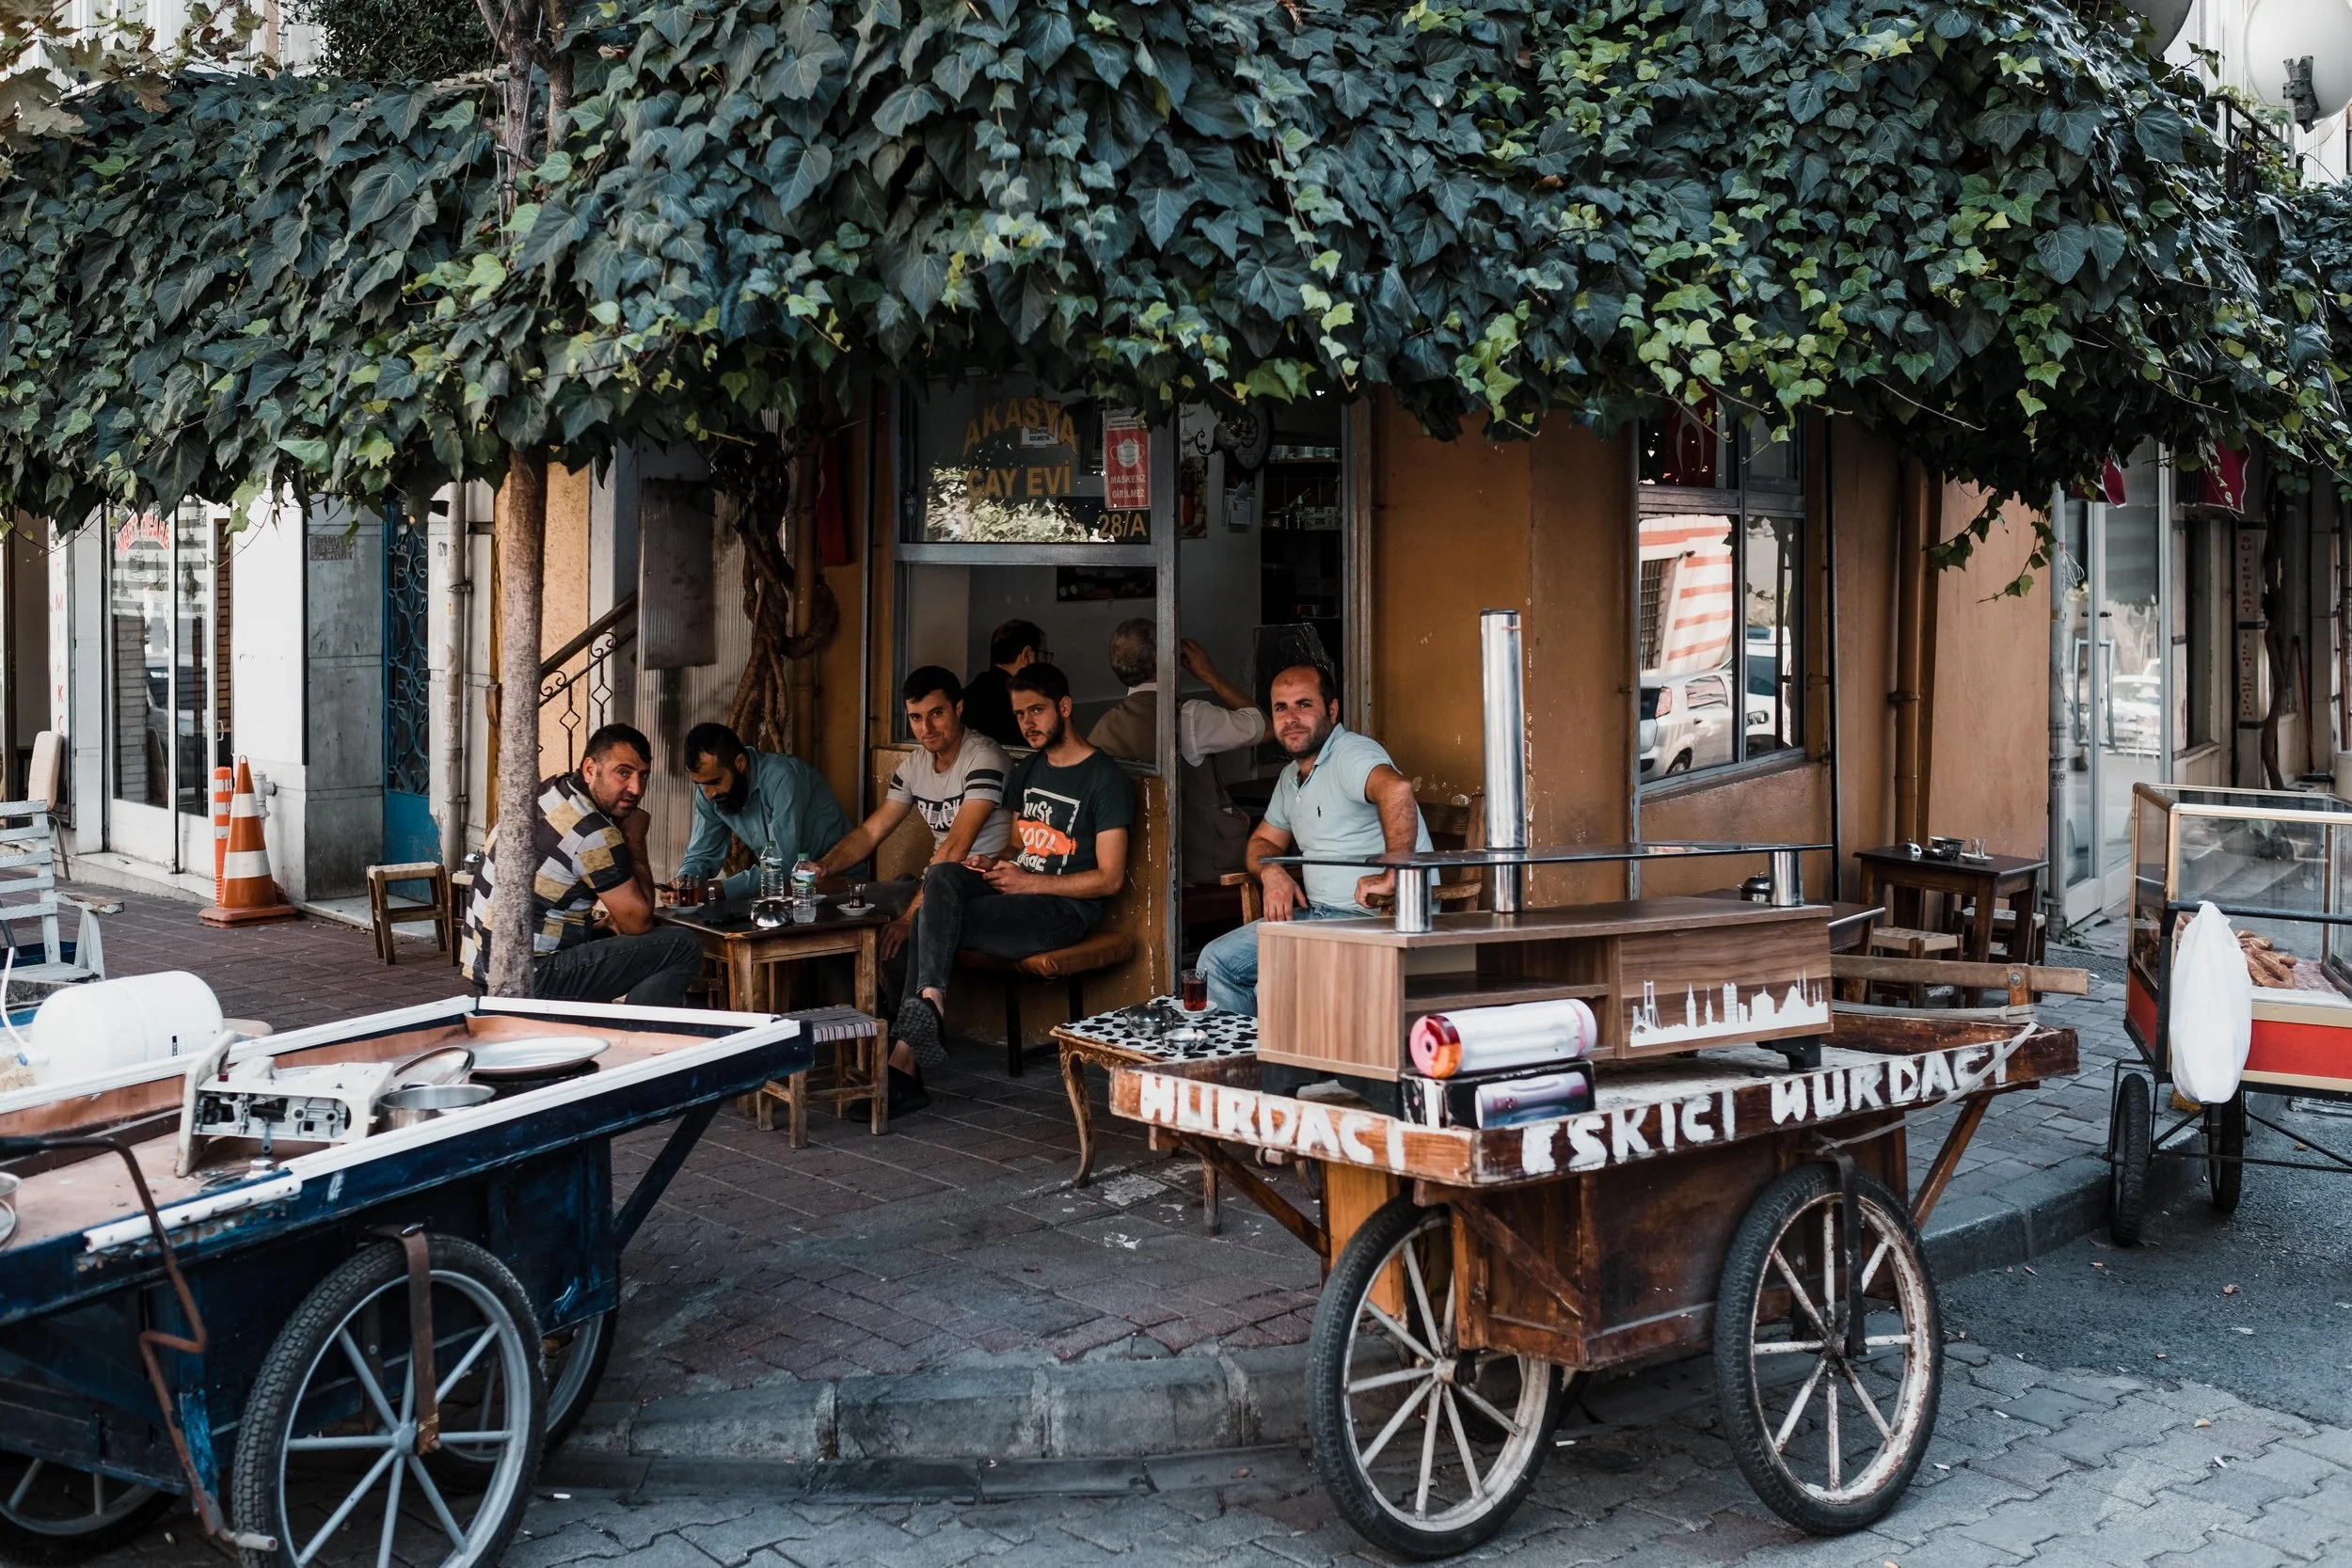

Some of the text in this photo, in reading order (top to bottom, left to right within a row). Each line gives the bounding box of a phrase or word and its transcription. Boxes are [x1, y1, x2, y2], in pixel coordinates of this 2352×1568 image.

[962, 396, 1079, 458] AKASYA
[1026, 458, 1072, 497] EVİ
[1097, 513, 1148, 538] 28/A
[1018, 827, 1057, 852] OOL
